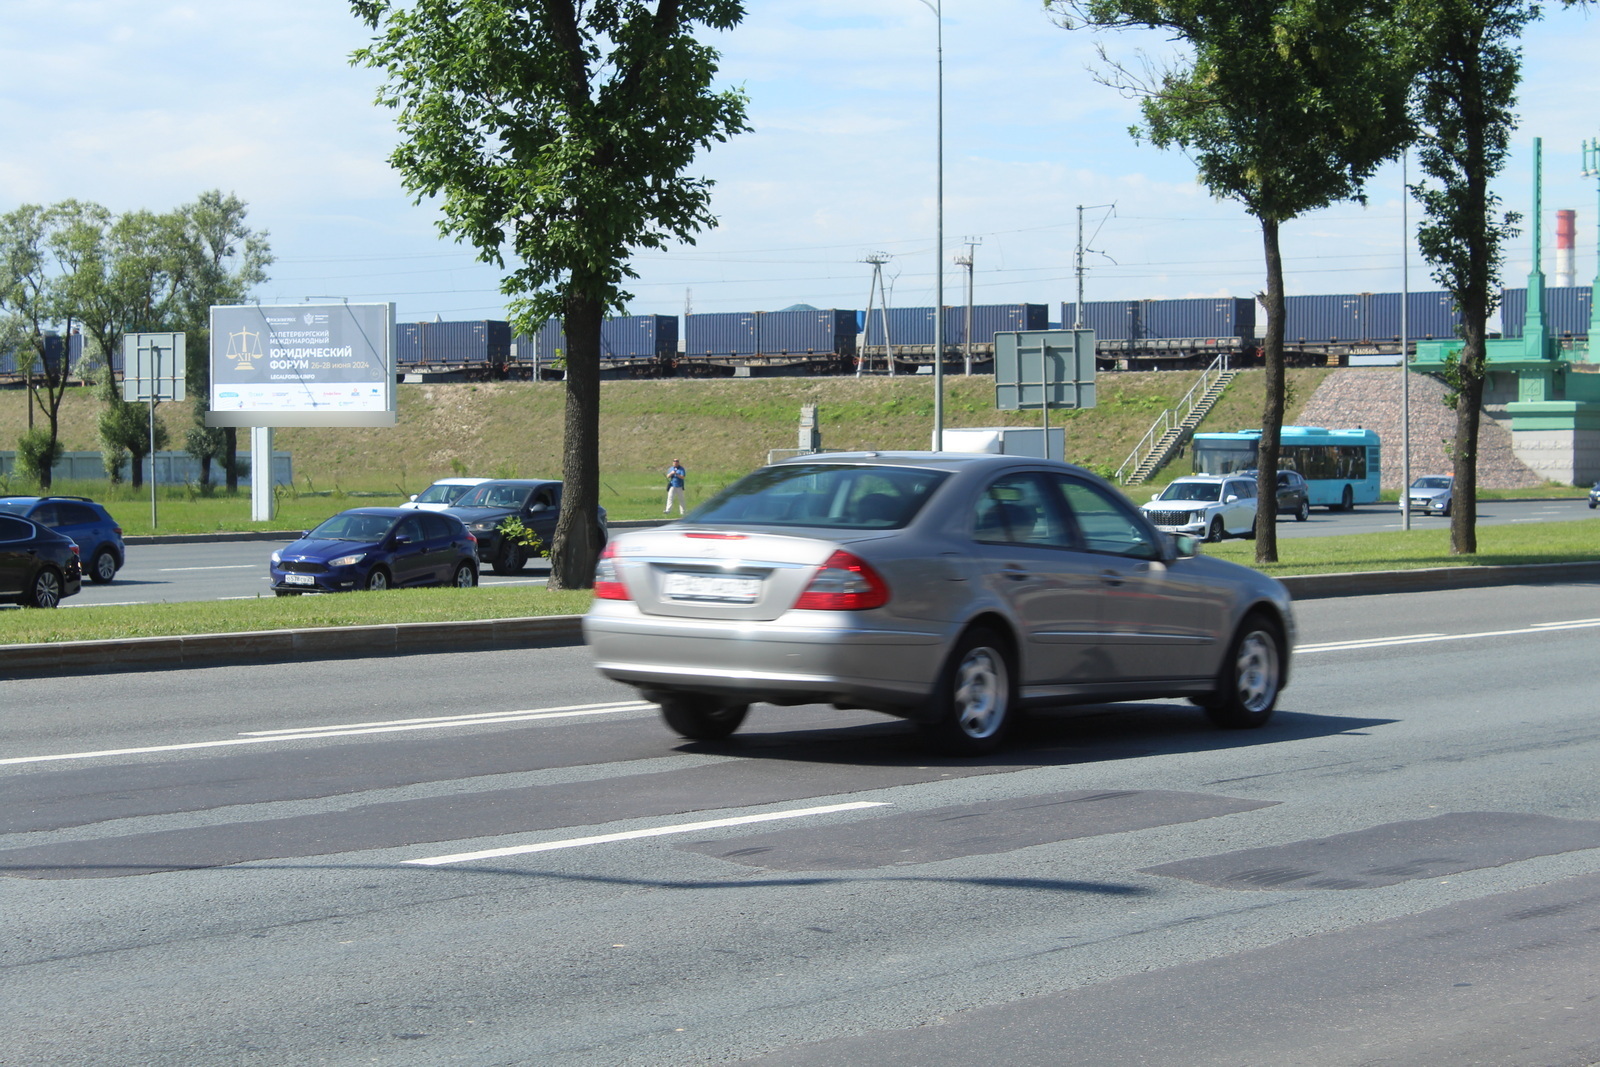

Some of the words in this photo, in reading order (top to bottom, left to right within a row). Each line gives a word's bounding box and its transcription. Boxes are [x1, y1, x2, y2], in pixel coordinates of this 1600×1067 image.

[278, 329, 330, 338] ПЕТЕРБУРГСКИЙ
[269, 337, 330, 345] МЕЖДУНАРОДНЫЙ
[270, 345, 352, 359] ЮРИДИЧЕСКИЙ
[269, 359, 309, 370] ФОРУМ
[352, 361, 370, 369] 2024
